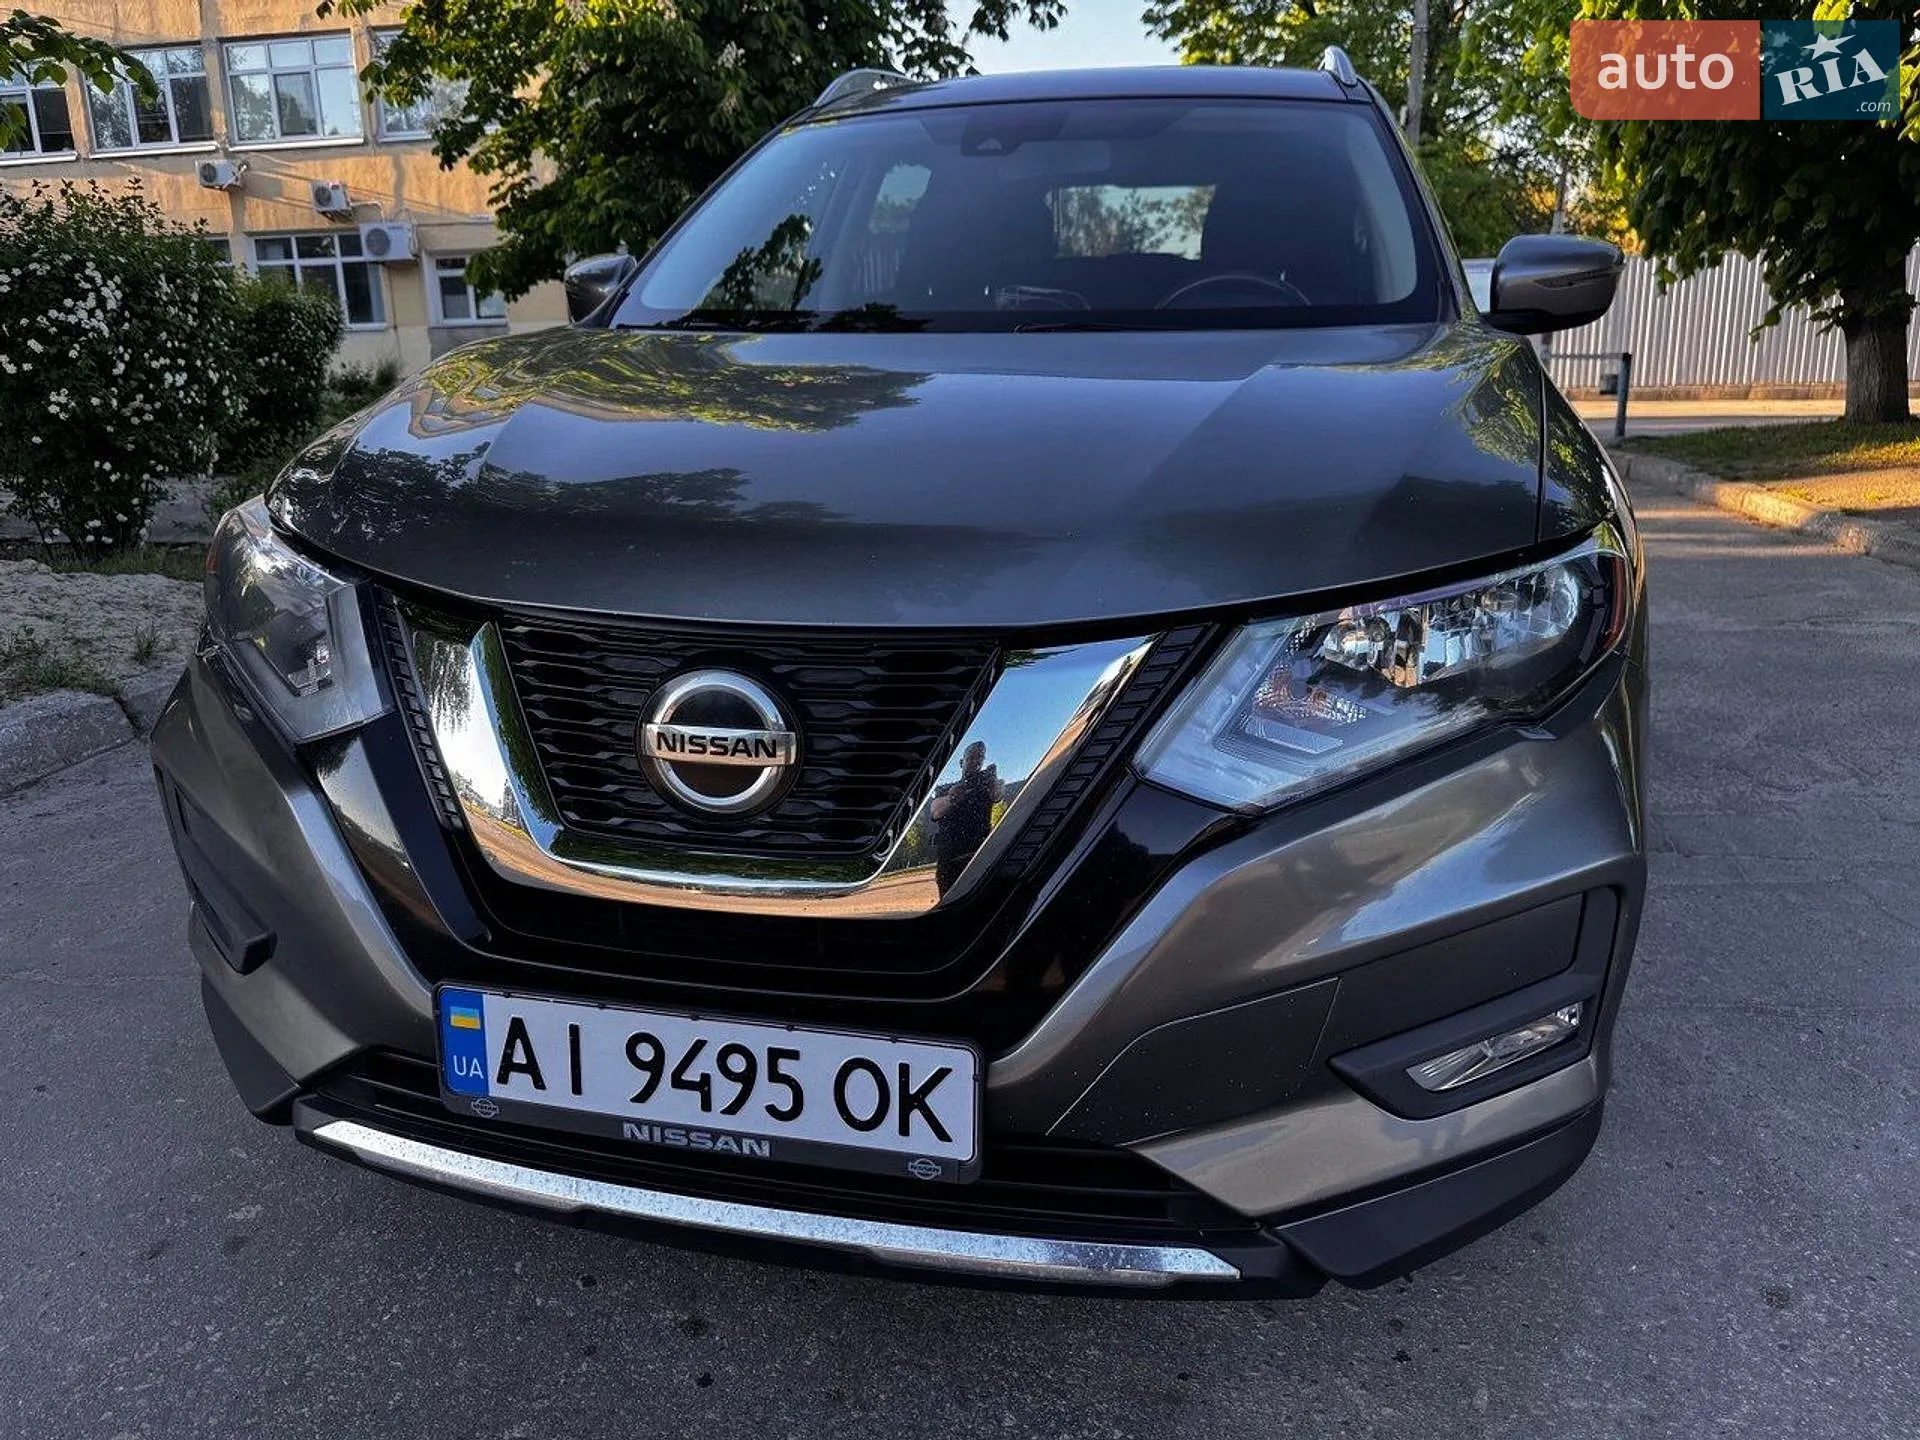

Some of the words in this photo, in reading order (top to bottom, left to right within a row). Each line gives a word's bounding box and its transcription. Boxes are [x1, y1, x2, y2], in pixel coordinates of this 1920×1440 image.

[656, 731, 777, 758] NISSAN
[453, 1055, 484, 1079] UA
[625, 1032, 805, 1122] 9495
[833, 1056, 953, 1143] OK
[623, 1122, 771, 1157] NISSAN
